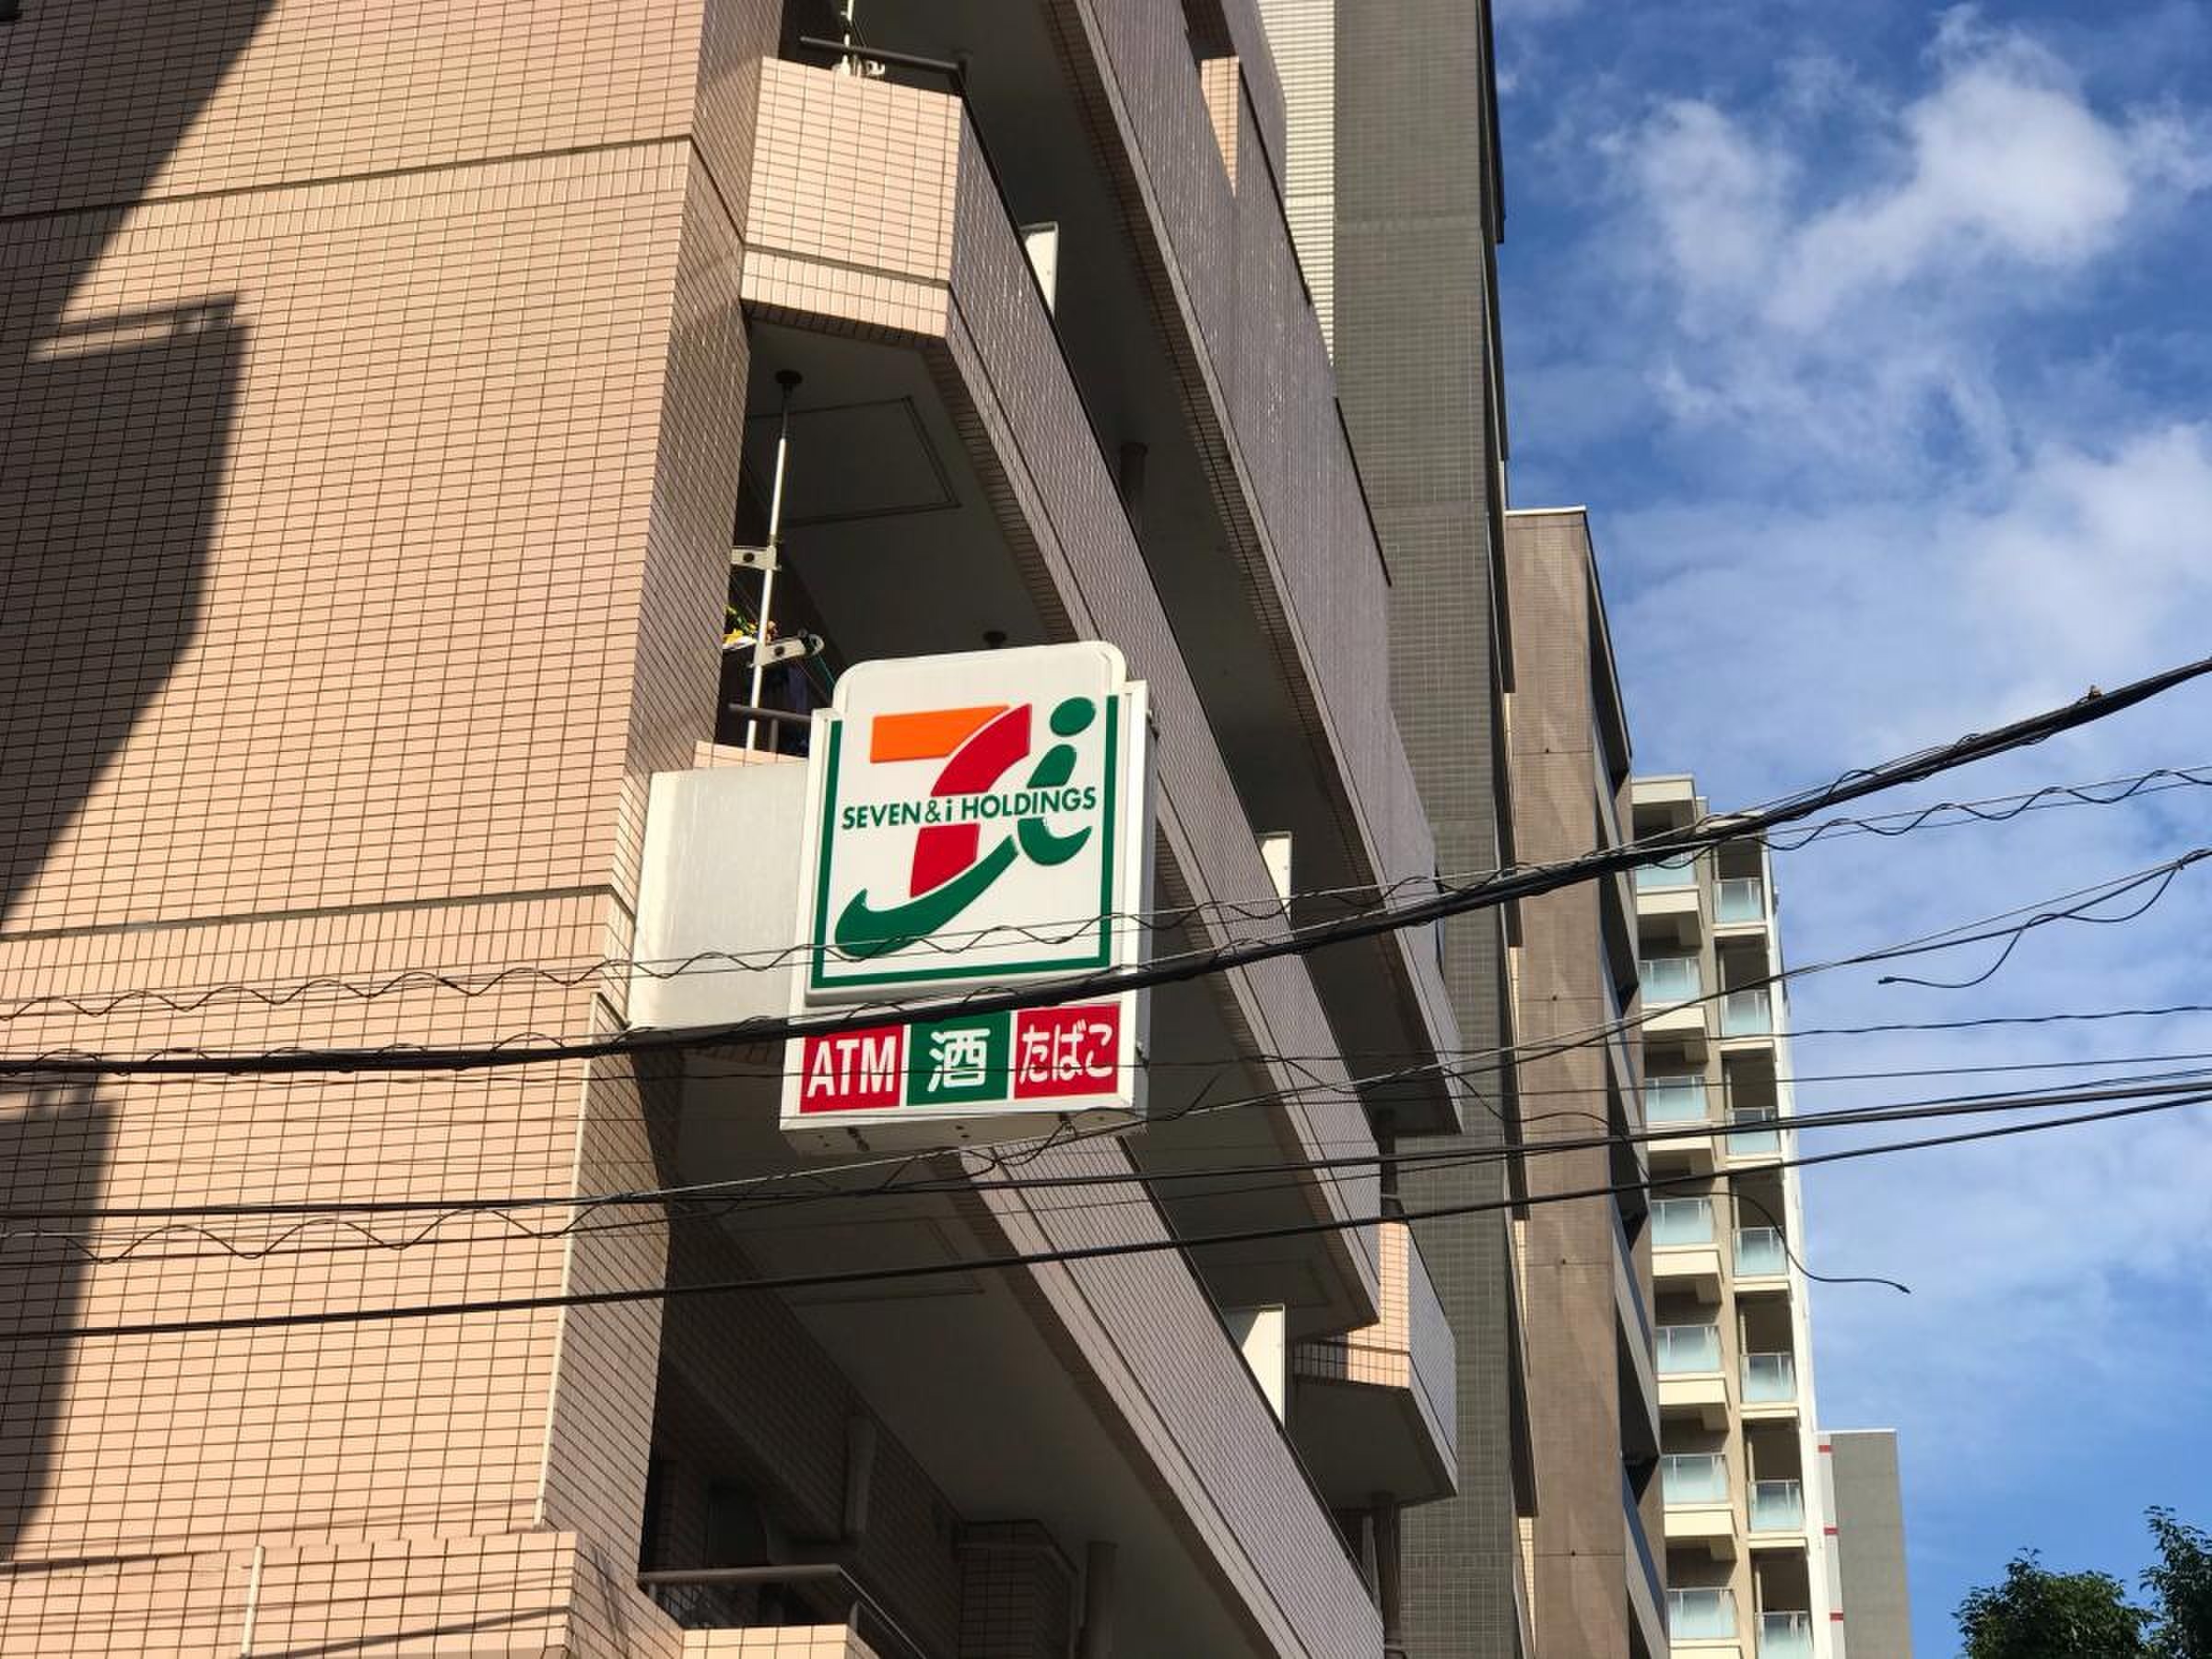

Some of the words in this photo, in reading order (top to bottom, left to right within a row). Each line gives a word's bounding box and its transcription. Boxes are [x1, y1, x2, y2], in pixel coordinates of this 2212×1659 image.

[961, 786, 1097, 821] HOLDINGS
[806, 1035, 897, 1098] ATM
[928, 1028, 991, 1092] 酒
[1019, 1019, 1112, 1085] たばこ
